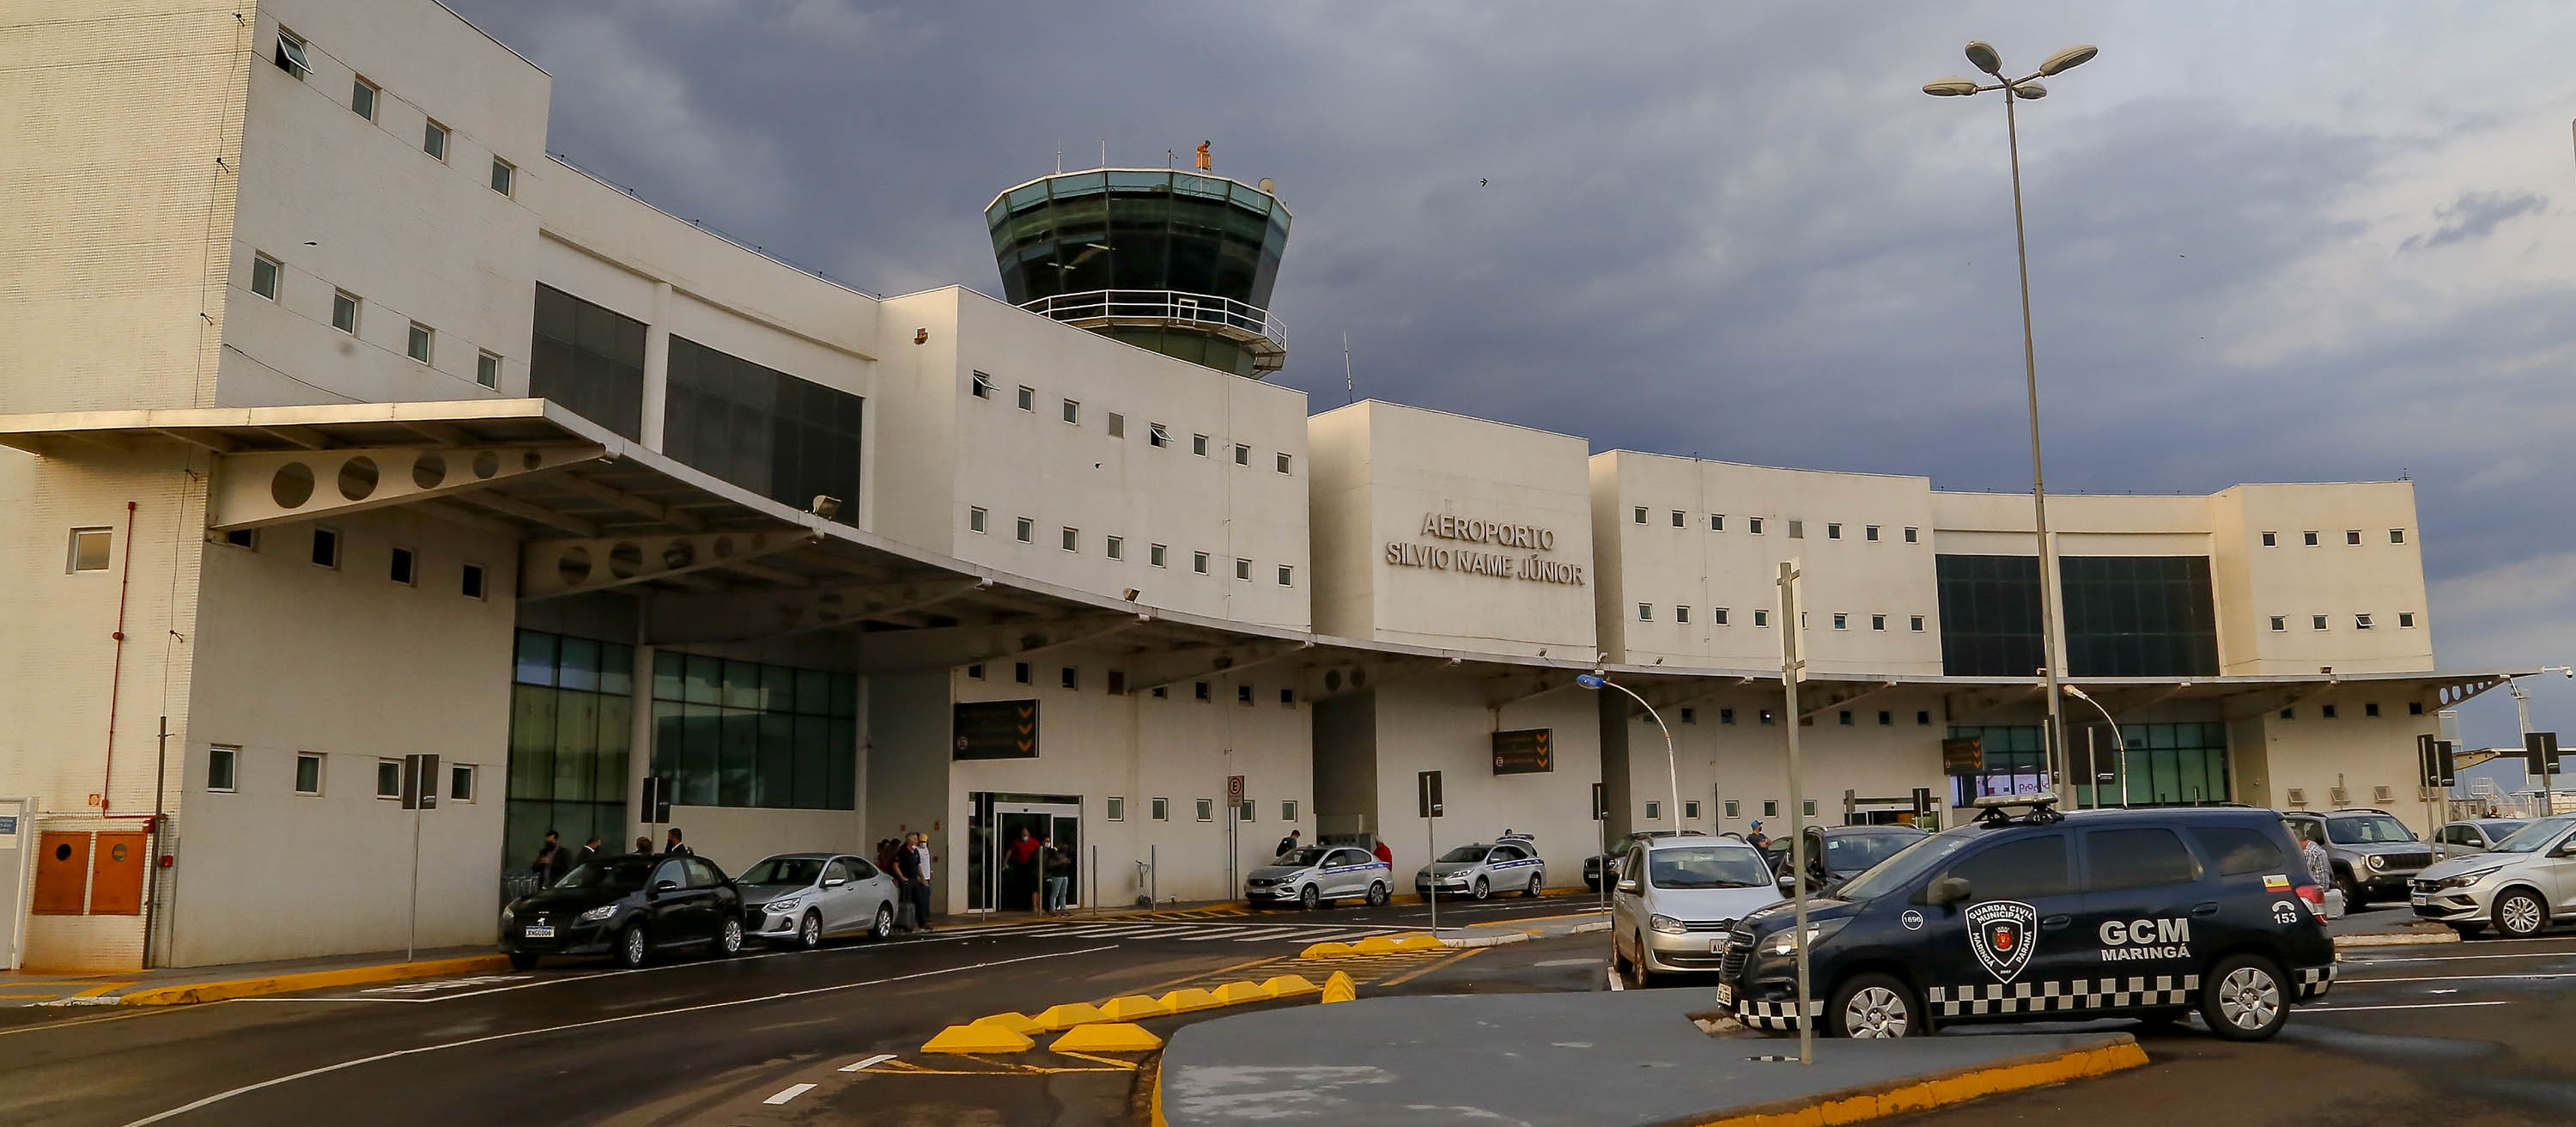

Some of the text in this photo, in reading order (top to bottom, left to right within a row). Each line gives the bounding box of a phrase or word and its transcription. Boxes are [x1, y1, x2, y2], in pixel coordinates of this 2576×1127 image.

[1421, 513, 1555, 551] AEROPORTO
[1386, 542, 1586, 586] SILVIO NAME JÚNIOR
[1969, 905, 2033, 920] GUARDA CIVIL
[1977, 911, 2026, 924] MUNICIPAL
[2274, 912, 2297, 924] 153
[2099, 918, 2190, 946] GCM
[1972, 932, 1996, 967] MARINGÁ
[2015, 930, 2032, 964] PARANÁ
[2100, 943, 2191, 961] MARINGÁ
